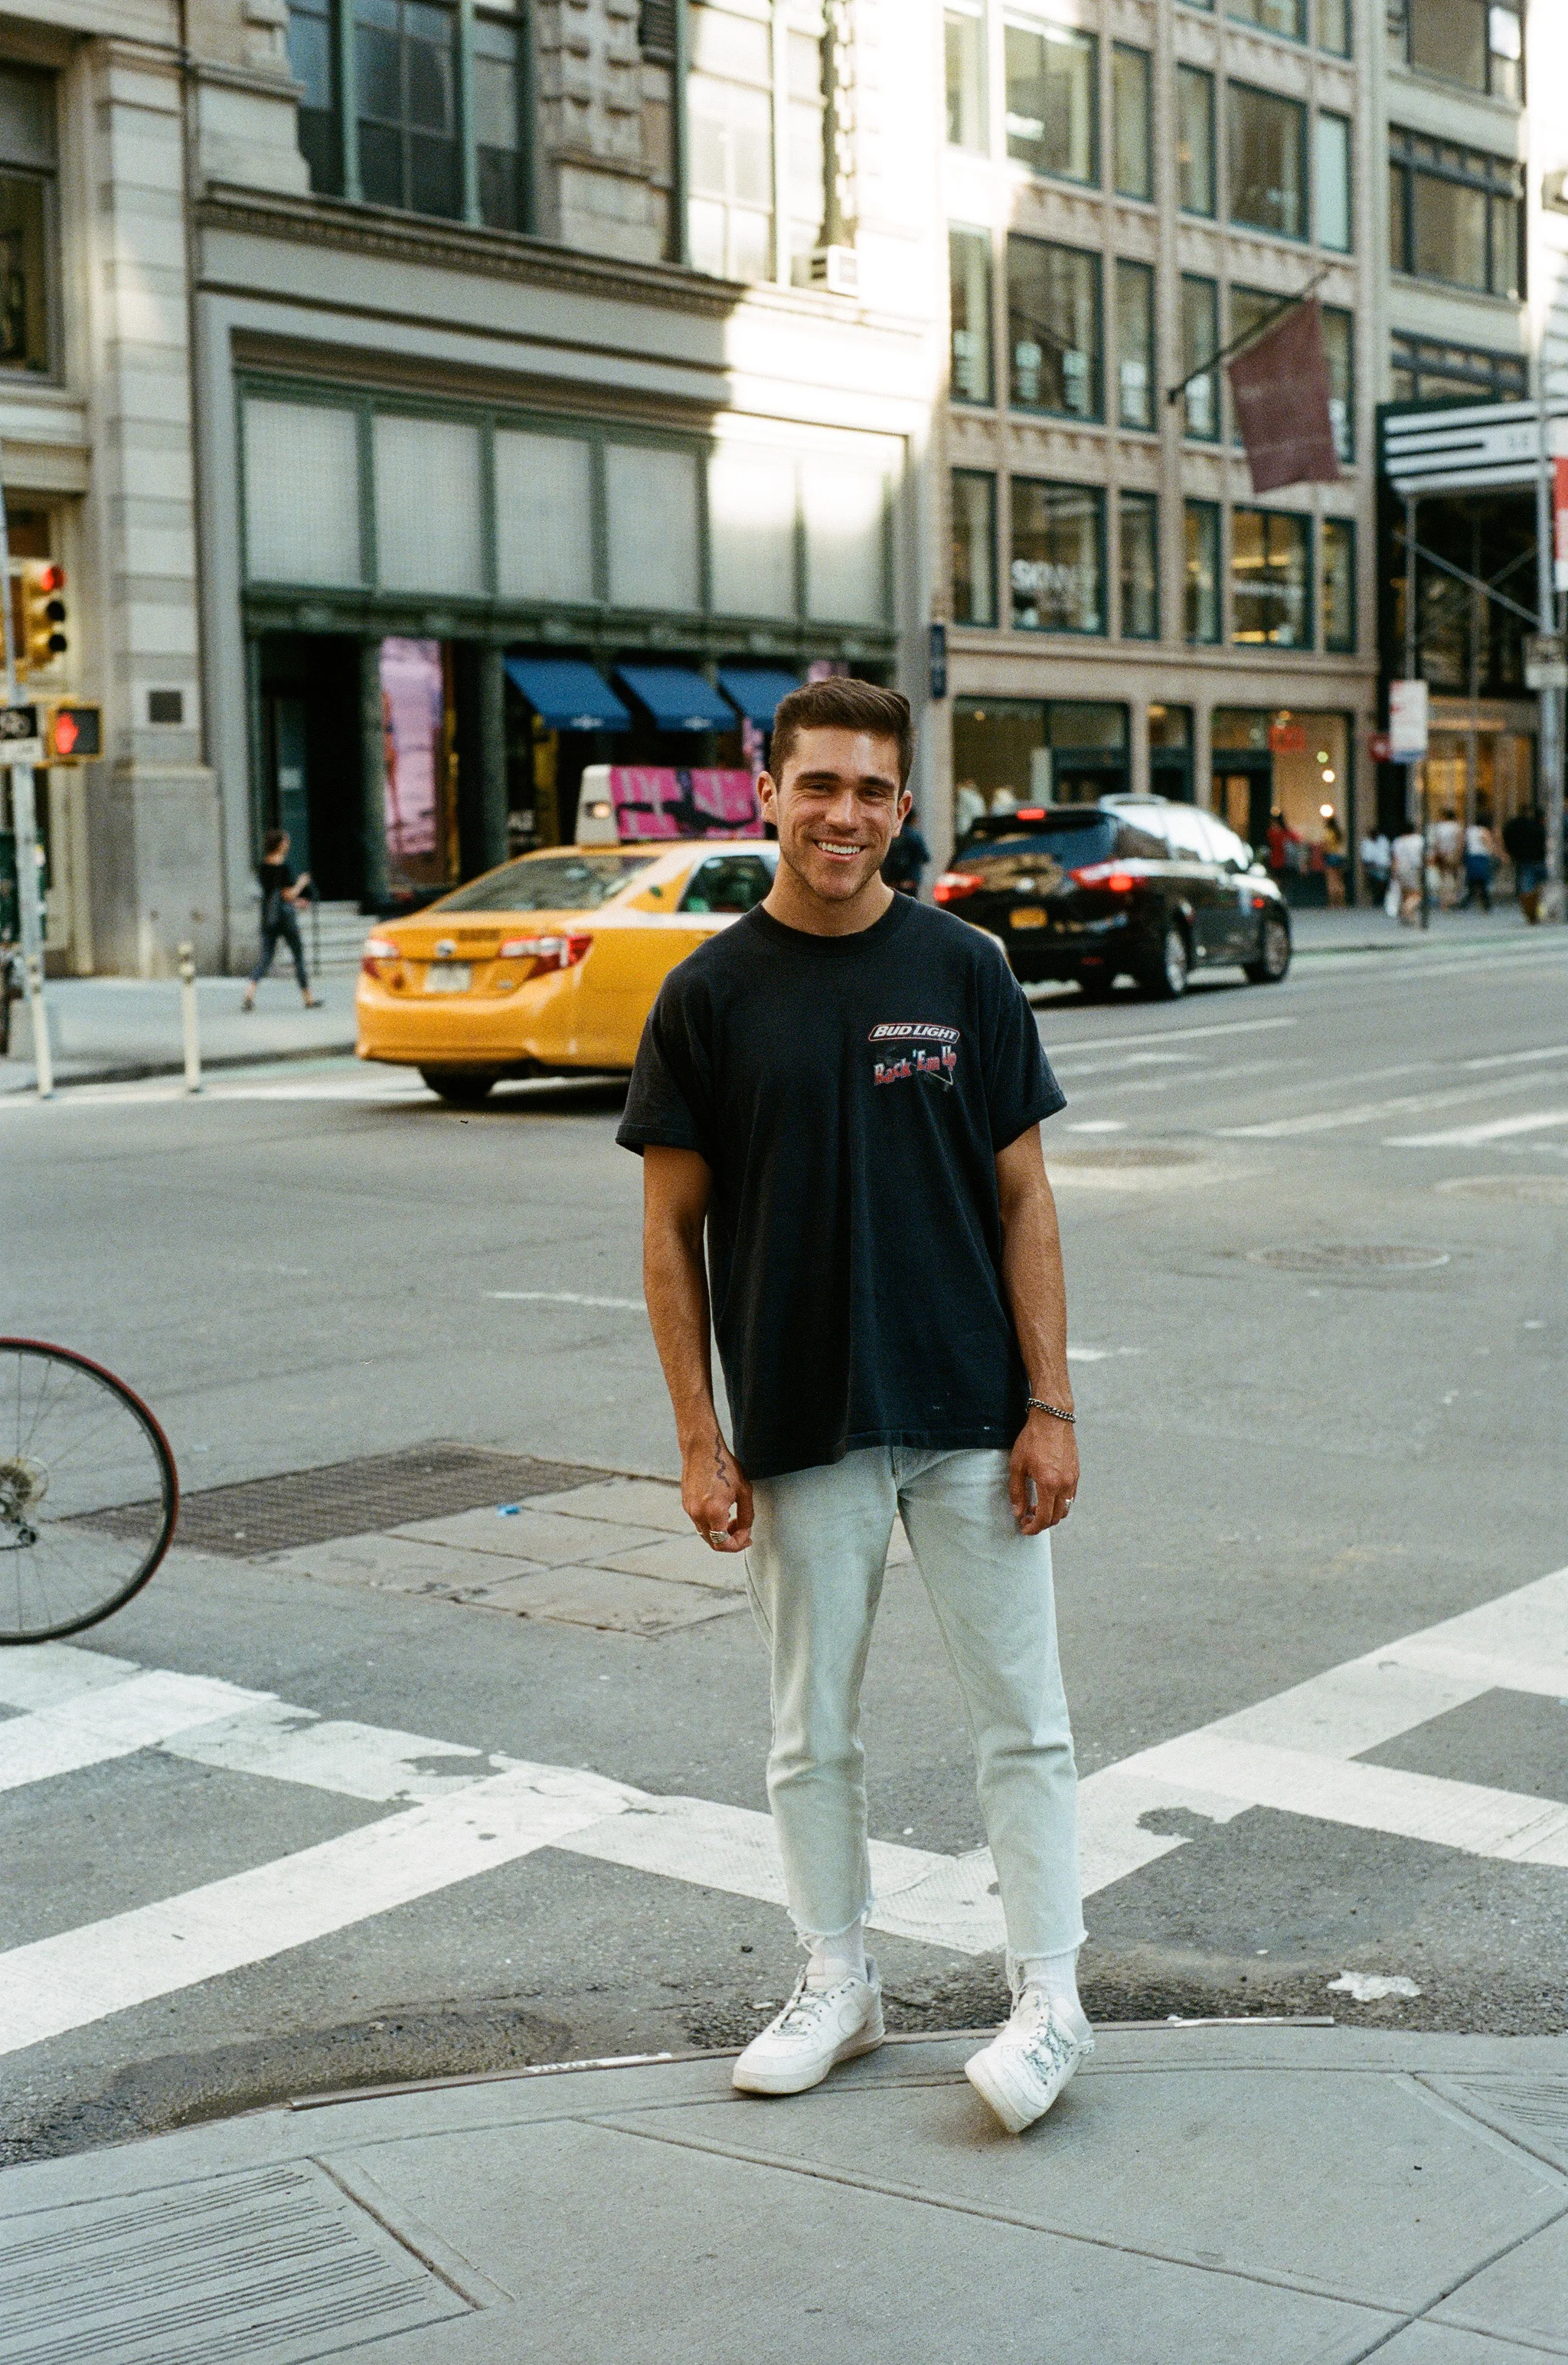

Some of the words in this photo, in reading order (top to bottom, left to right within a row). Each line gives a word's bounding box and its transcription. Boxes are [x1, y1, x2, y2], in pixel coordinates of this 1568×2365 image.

[874, 1025, 912, 1037] BUD
[913, 1025, 956, 1039] LIGHT
[941, 1045, 957, 1071] Up
